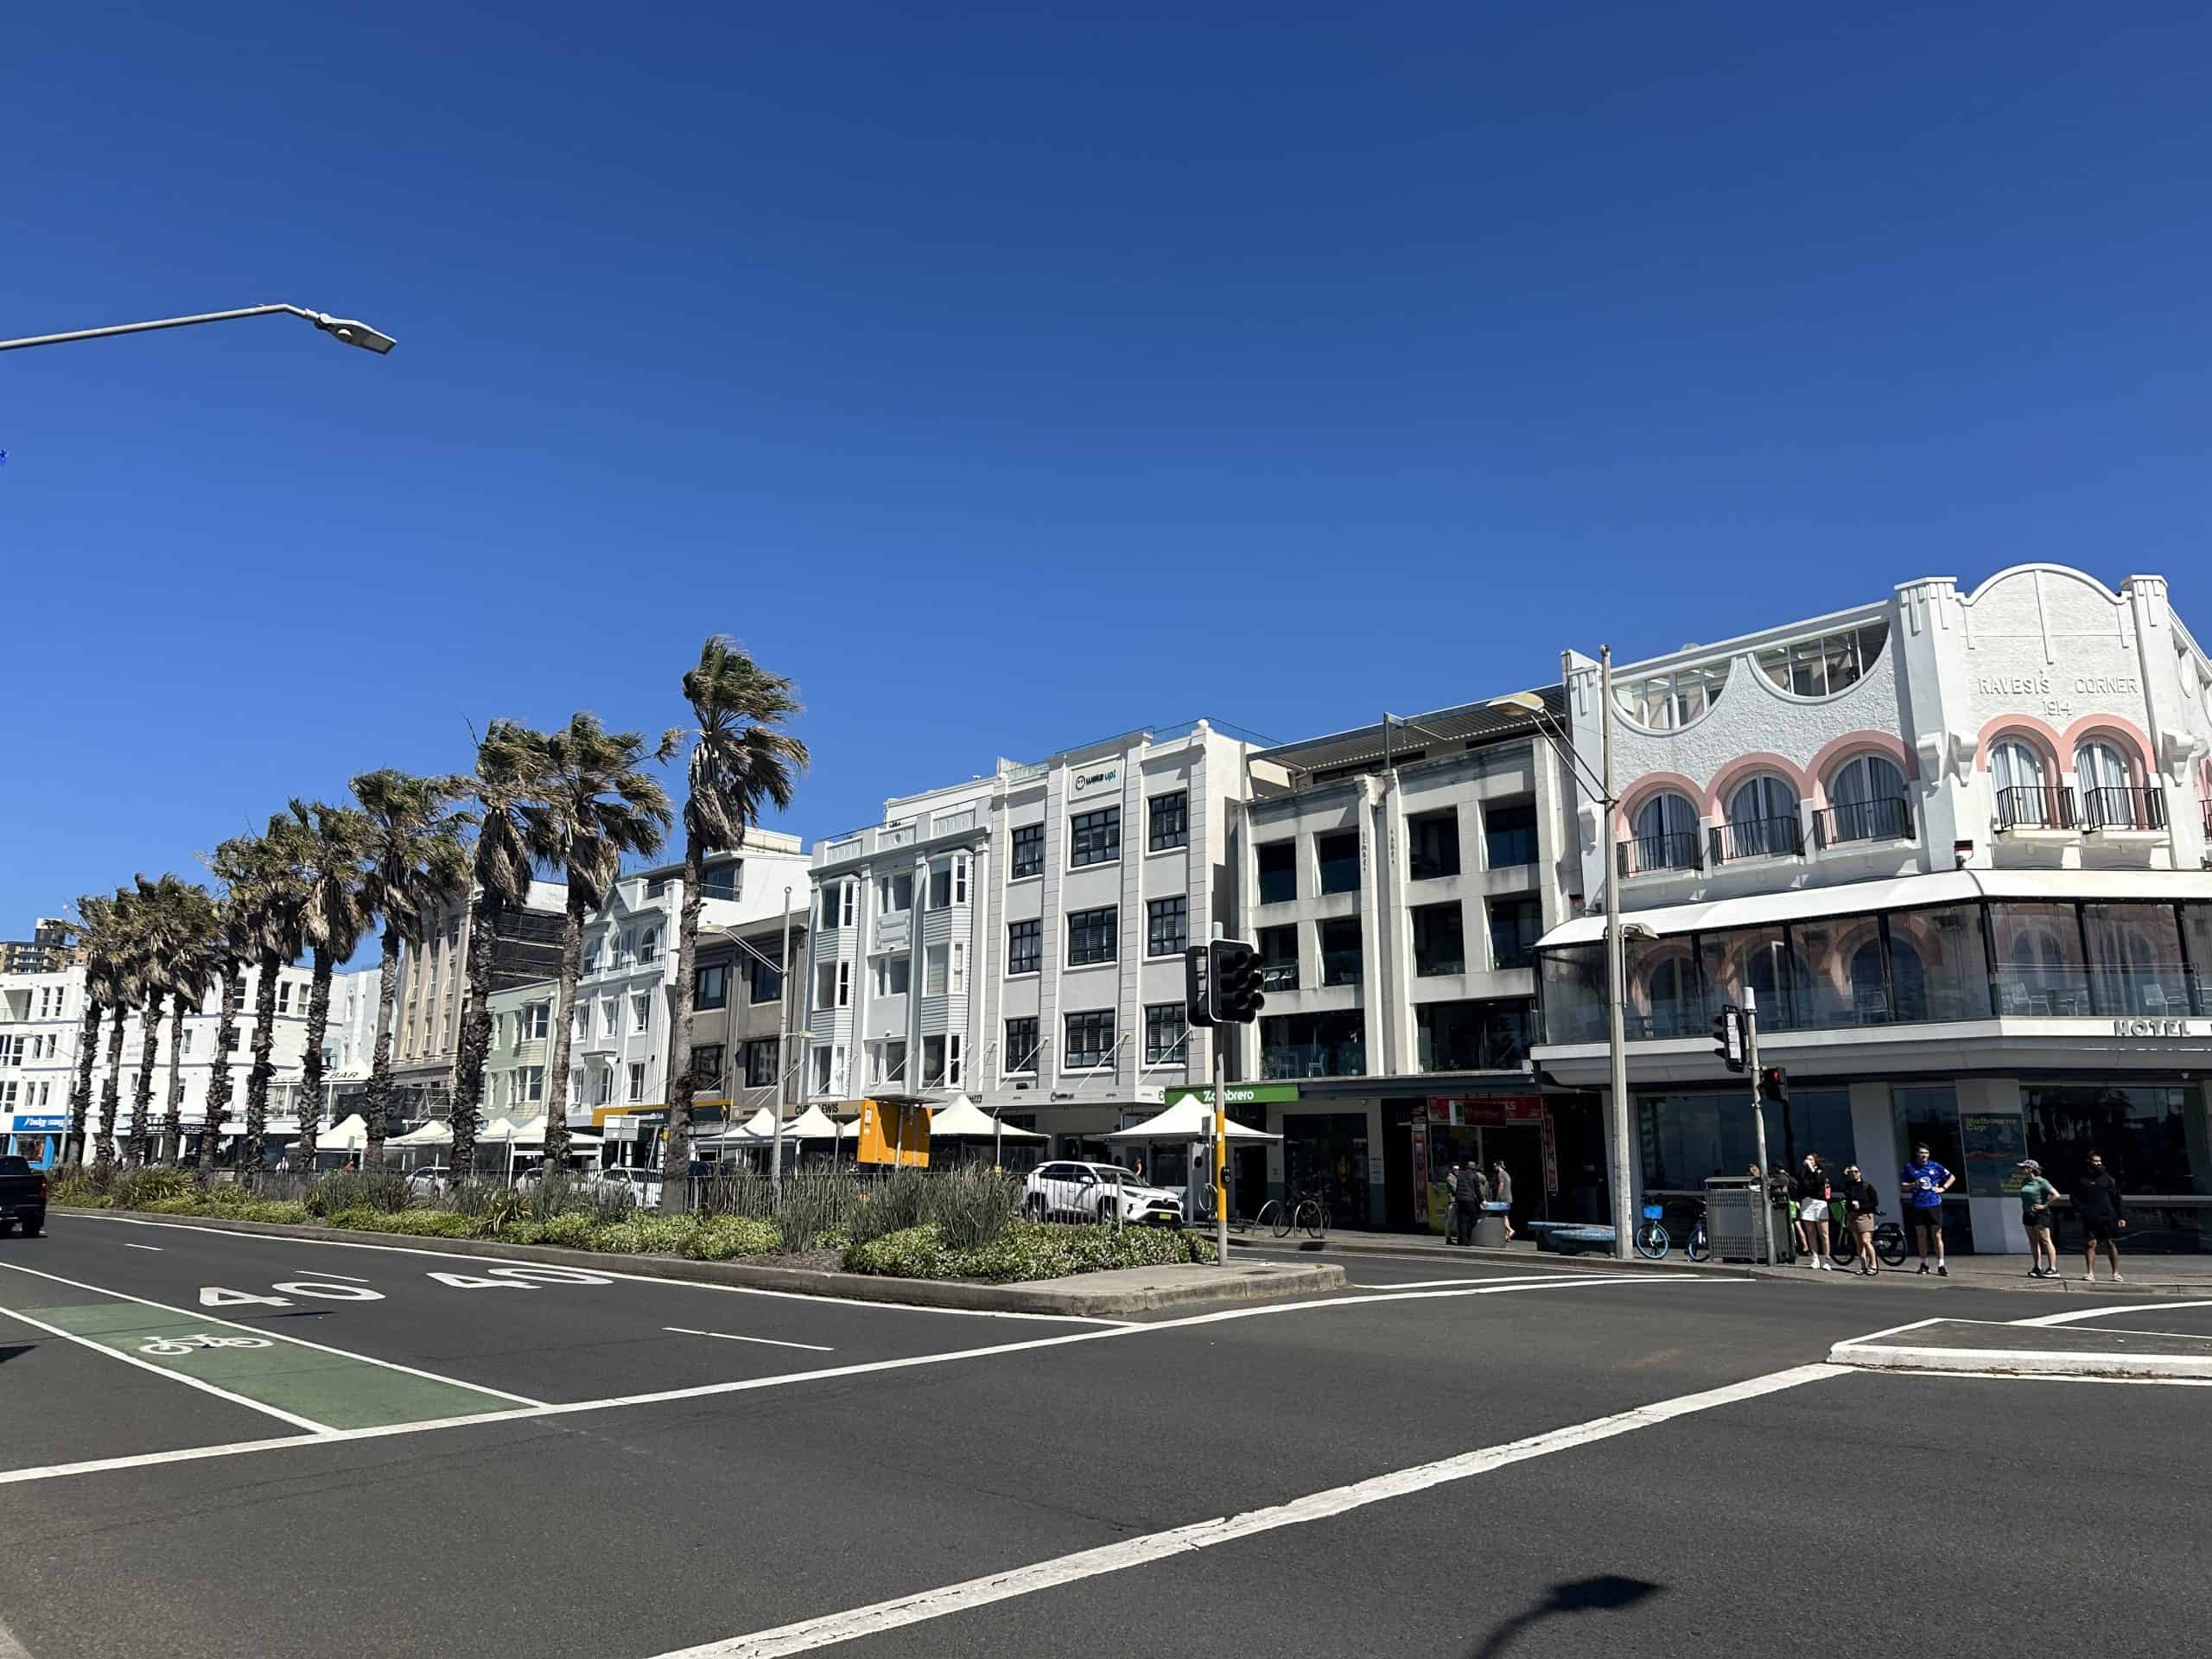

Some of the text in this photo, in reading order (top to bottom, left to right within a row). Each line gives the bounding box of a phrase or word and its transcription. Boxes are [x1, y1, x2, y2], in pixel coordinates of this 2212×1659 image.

[2074, 677, 2139, 695] CORNER
[2042, 701, 2073, 716] 1914
[2113, 1018, 2191, 1037] HOTEL
[425, 1268, 614, 1289] 40
[200, 1282, 386, 1306] 40
